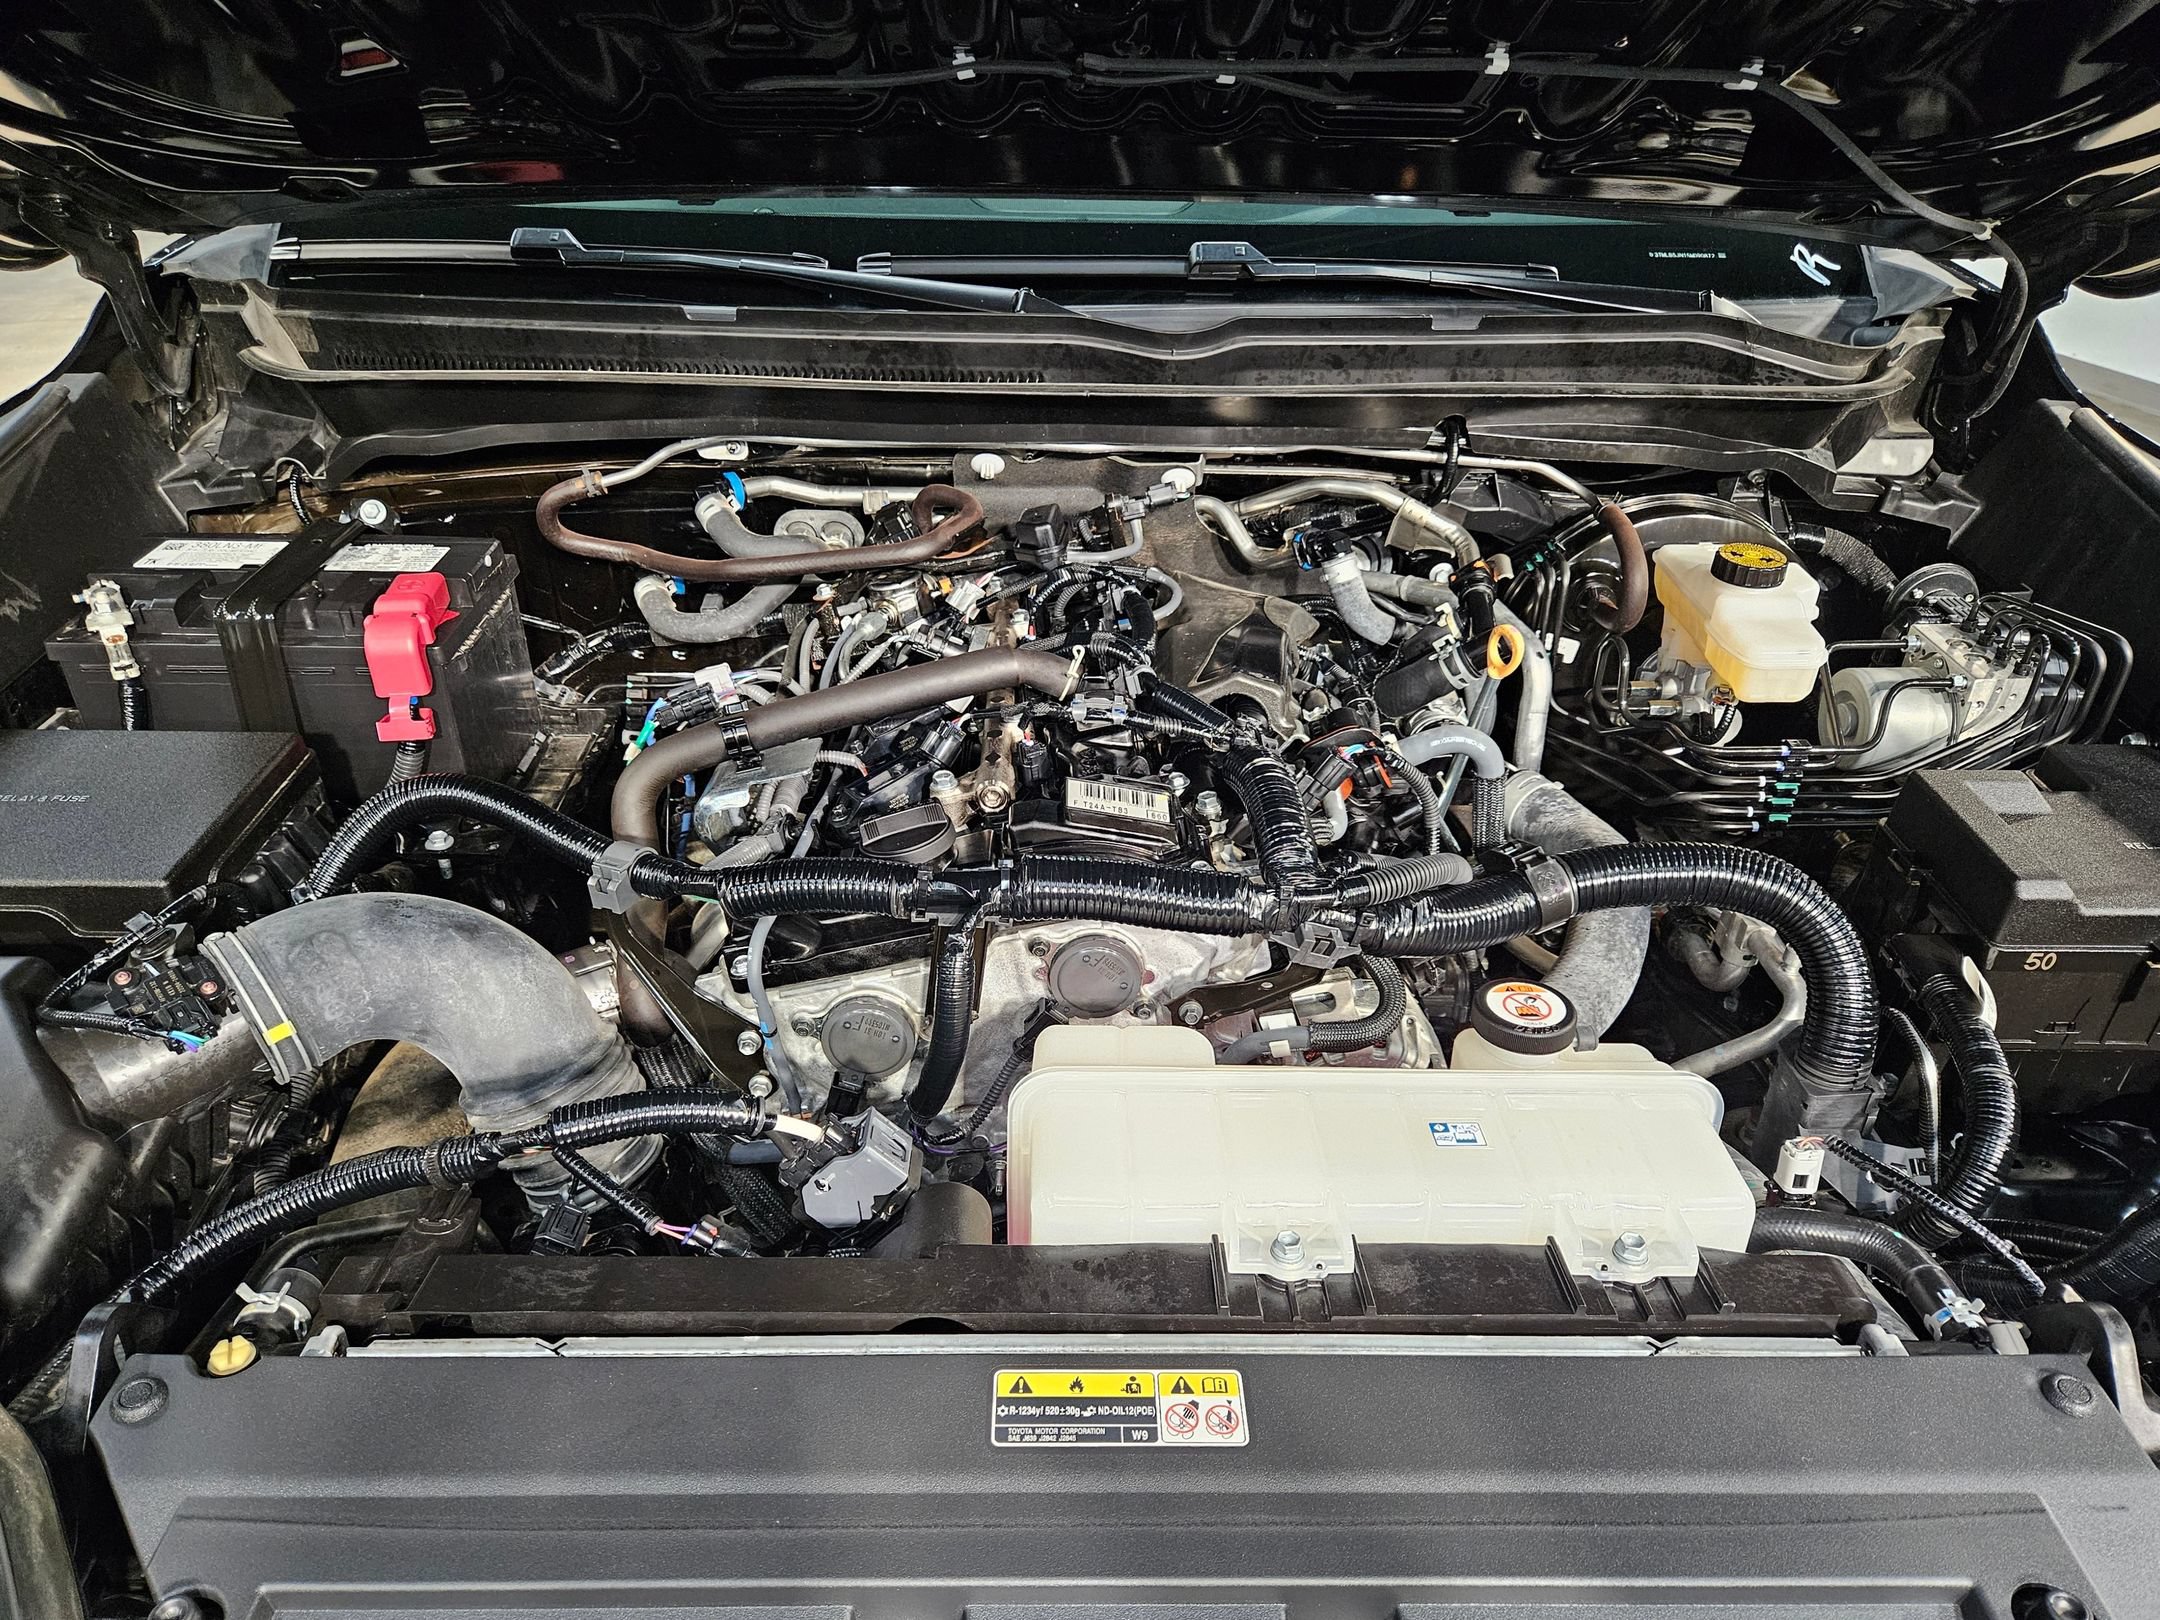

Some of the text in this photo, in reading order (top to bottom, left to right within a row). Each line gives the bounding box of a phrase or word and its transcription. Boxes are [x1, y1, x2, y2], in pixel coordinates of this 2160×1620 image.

[50, 794, 90, 803] FUSE
[2123, 842, 2160, 850] REL
[2023, 952, 2058, 971] 50
[1009, 1405, 1156, 1417] R-1234yf 520±30g ND-OIL12(POE)
[1007, 1427, 1106, 1435] TOYOTA MOTOR CORPORATION
[1131, 1429, 1149, 1441] W9
[1007, 1434, 1021, 1442] SAE
